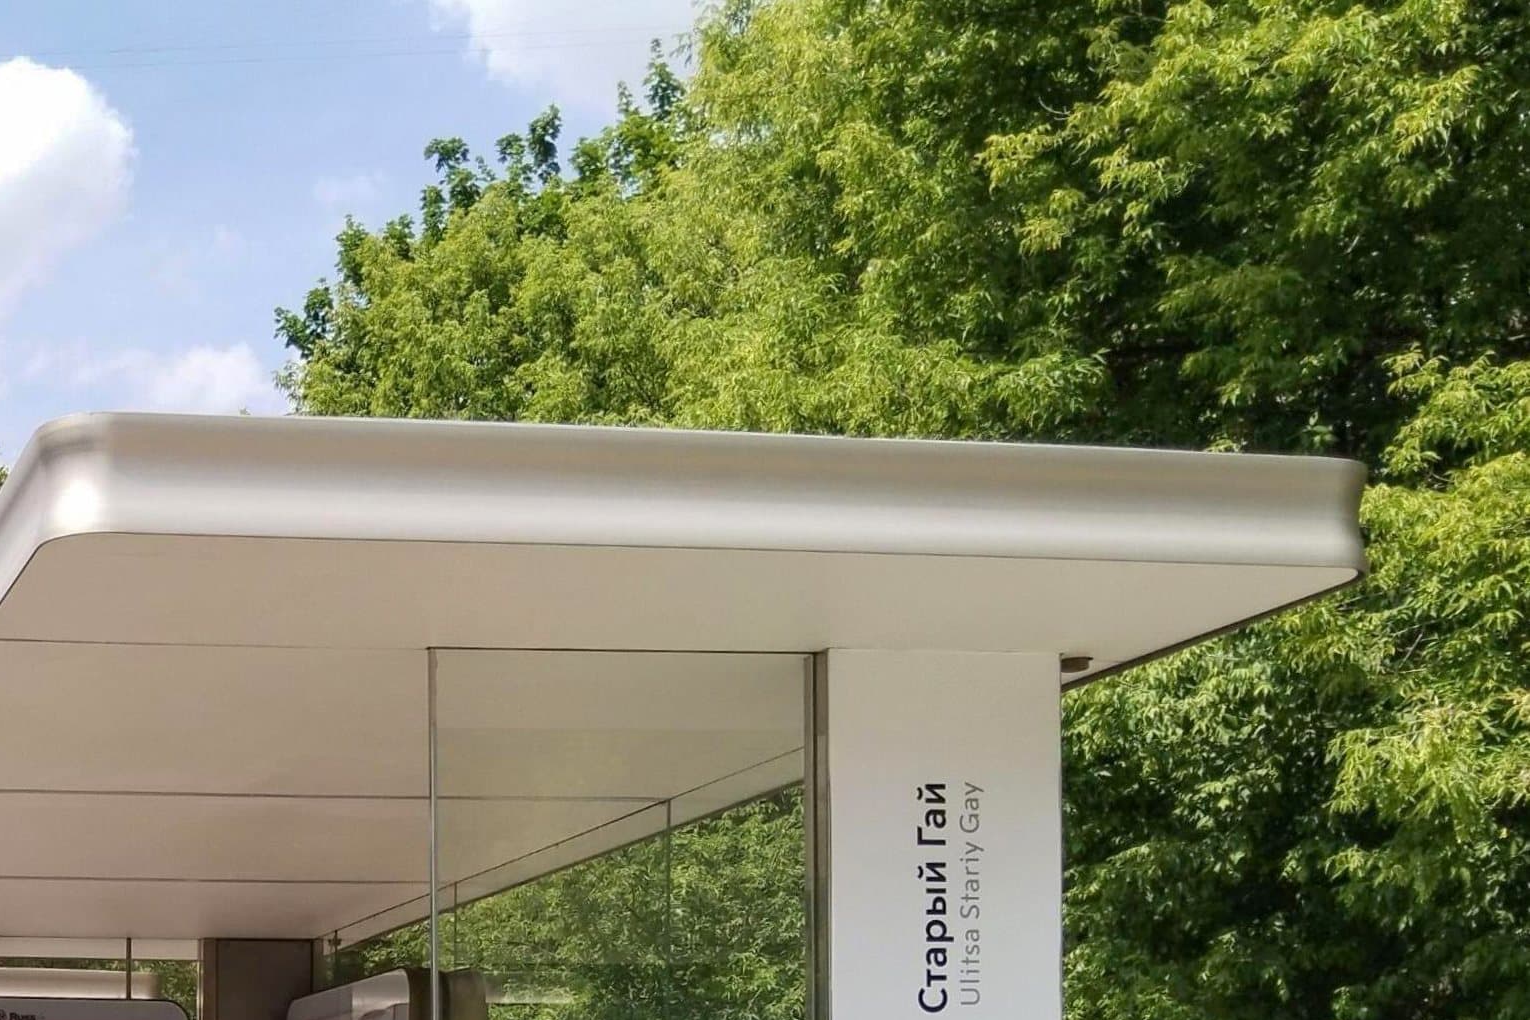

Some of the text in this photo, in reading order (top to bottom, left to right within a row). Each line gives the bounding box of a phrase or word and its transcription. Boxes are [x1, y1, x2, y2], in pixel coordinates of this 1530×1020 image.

[916, 782, 949, 846] Гай
[917, 861, 954, 1014] Старый
[959, 781, 984, 1006] Ulitsa Stariy Gay
